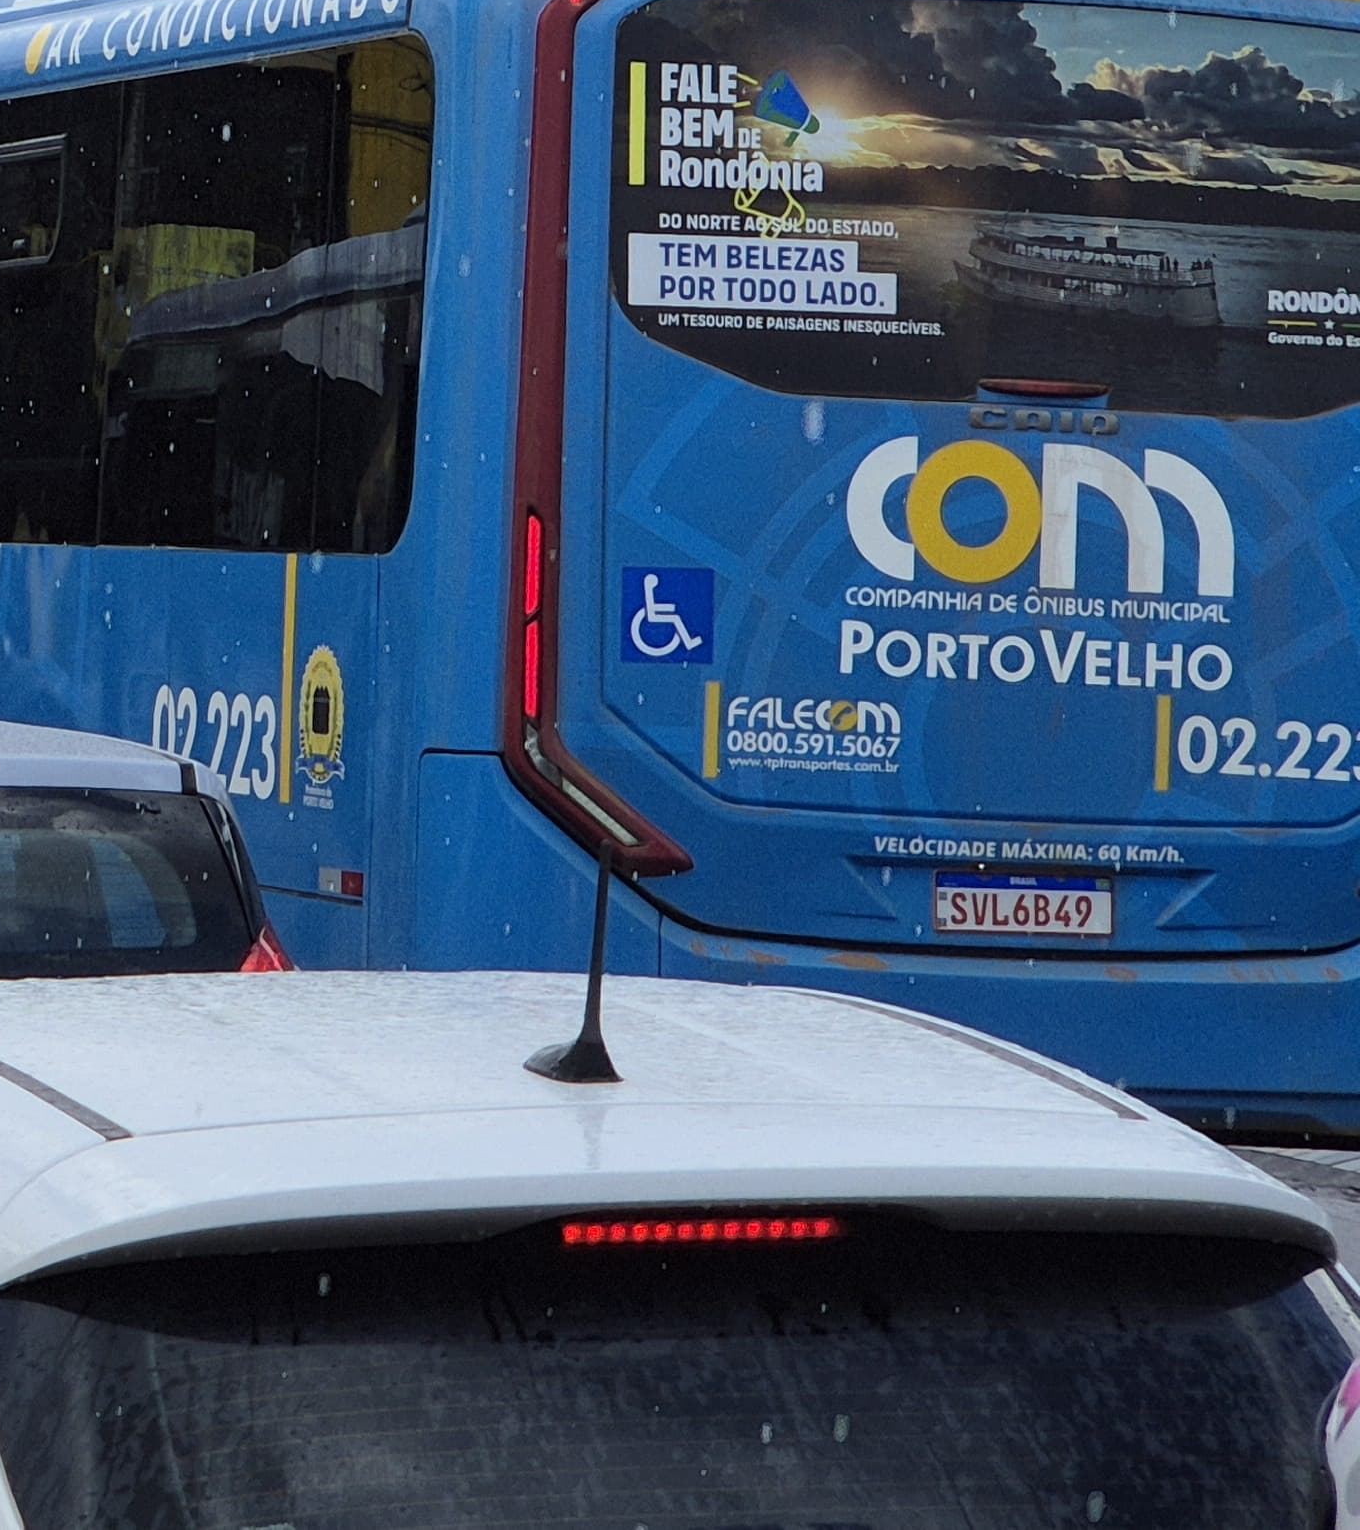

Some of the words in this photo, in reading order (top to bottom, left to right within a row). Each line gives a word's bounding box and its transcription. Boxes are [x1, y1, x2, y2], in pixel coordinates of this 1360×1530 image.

[45, 18, 92, 68] AR
[660, 62, 738, 104] FALE
[660, 106, 734, 148] BEM
[737, 128, 761, 149] DE
[659, 149, 824, 192] Rondônia
[659, 213, 682, 229] DO
[686, 214, 741, 231] NORTE
[744, 216, 766, 232] AO
[805, 219, 828, 235] DO
[833, 220, 899, 238] ESTADO,
[659, 242, 717, 268] TEM
[726, 244, 846, 273] BELEZAS
[659, 275, 716, 301] POR
[723, 277, 797, 304] TODO
[805, 279, 885, 307] LADO.
[658, 313, 680, 327] UM
[682, 314, 743, 329] TESOURO
[746, 316, 764, 330] DE
[767, 317, 841, 332] PAISAGENS
[843, 318, 946, 337] INESQUECÍVEIS.
[1267, 331, 1324, 345] Governo
[1326, 334, 1343, 346] do
[970, 406, 1121, 436] CAIO
[845, 586, 982, 611] COMPANHIA
[989, 592, 1018, 614] DE
[1024, 587, 1105, 618] ÔNIBUS
[1111, 600, 1232, 624] MUNICIPAL
[727, 730, 902, 758] 0800.591.5067
[1178, 715, 1360, 782] 02.22
[874, 836, 996, 858] VELOCIDADE
[1001, 839, 1094, 862] MÁXIMA:
[1098, 844, 1121, 861] 60
[1126, 845, 1186, 864] Km/h.
[950, 892, 1094, 928] SVL6B49
